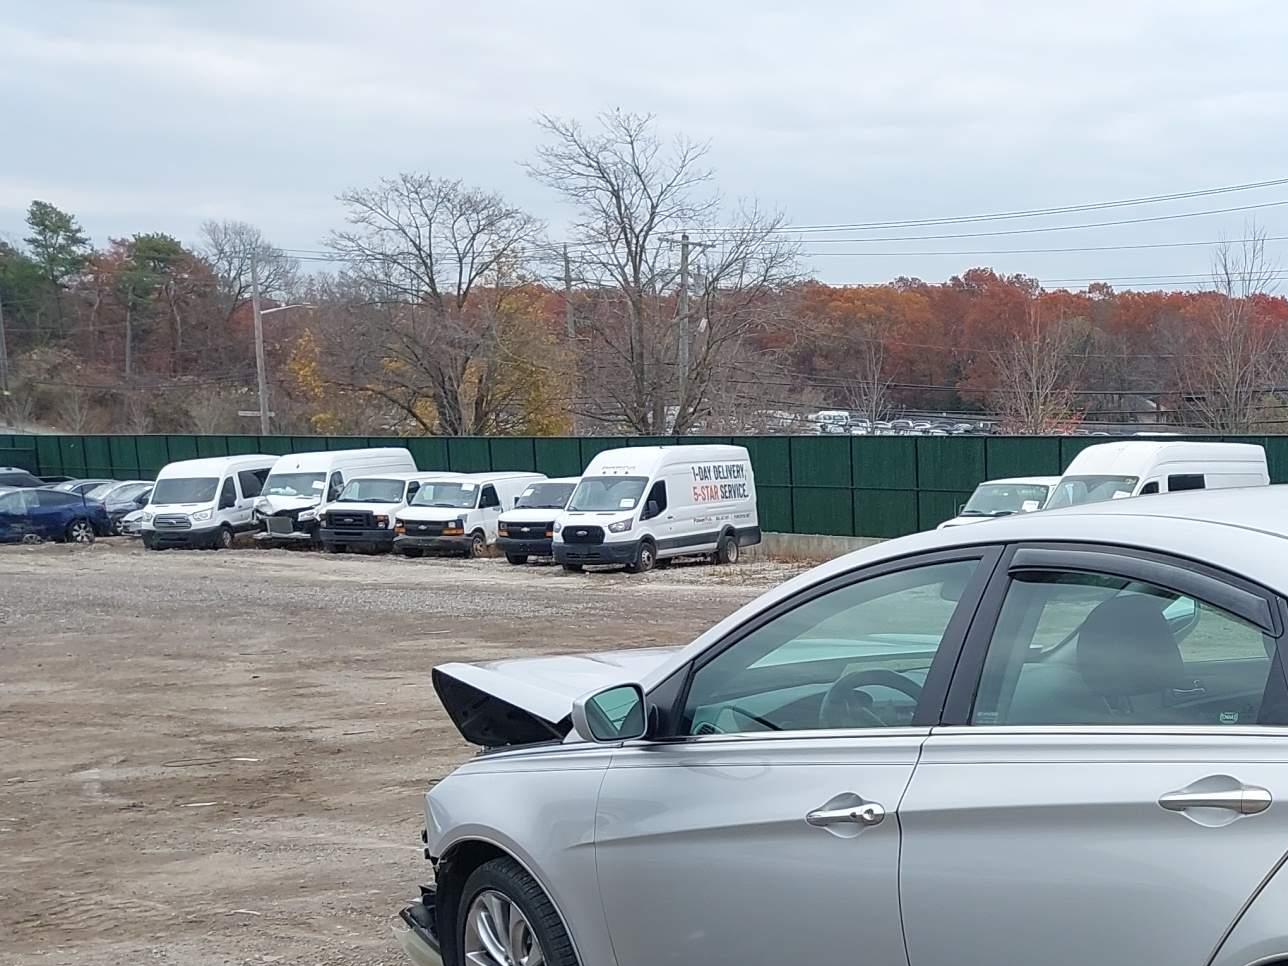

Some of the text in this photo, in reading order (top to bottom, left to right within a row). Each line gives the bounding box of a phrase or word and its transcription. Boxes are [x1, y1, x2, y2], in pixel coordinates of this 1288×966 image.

[691, 465, 712, 481] 1-DAY
[692, 483, 750, 502] 5-STAR SERVICE.
